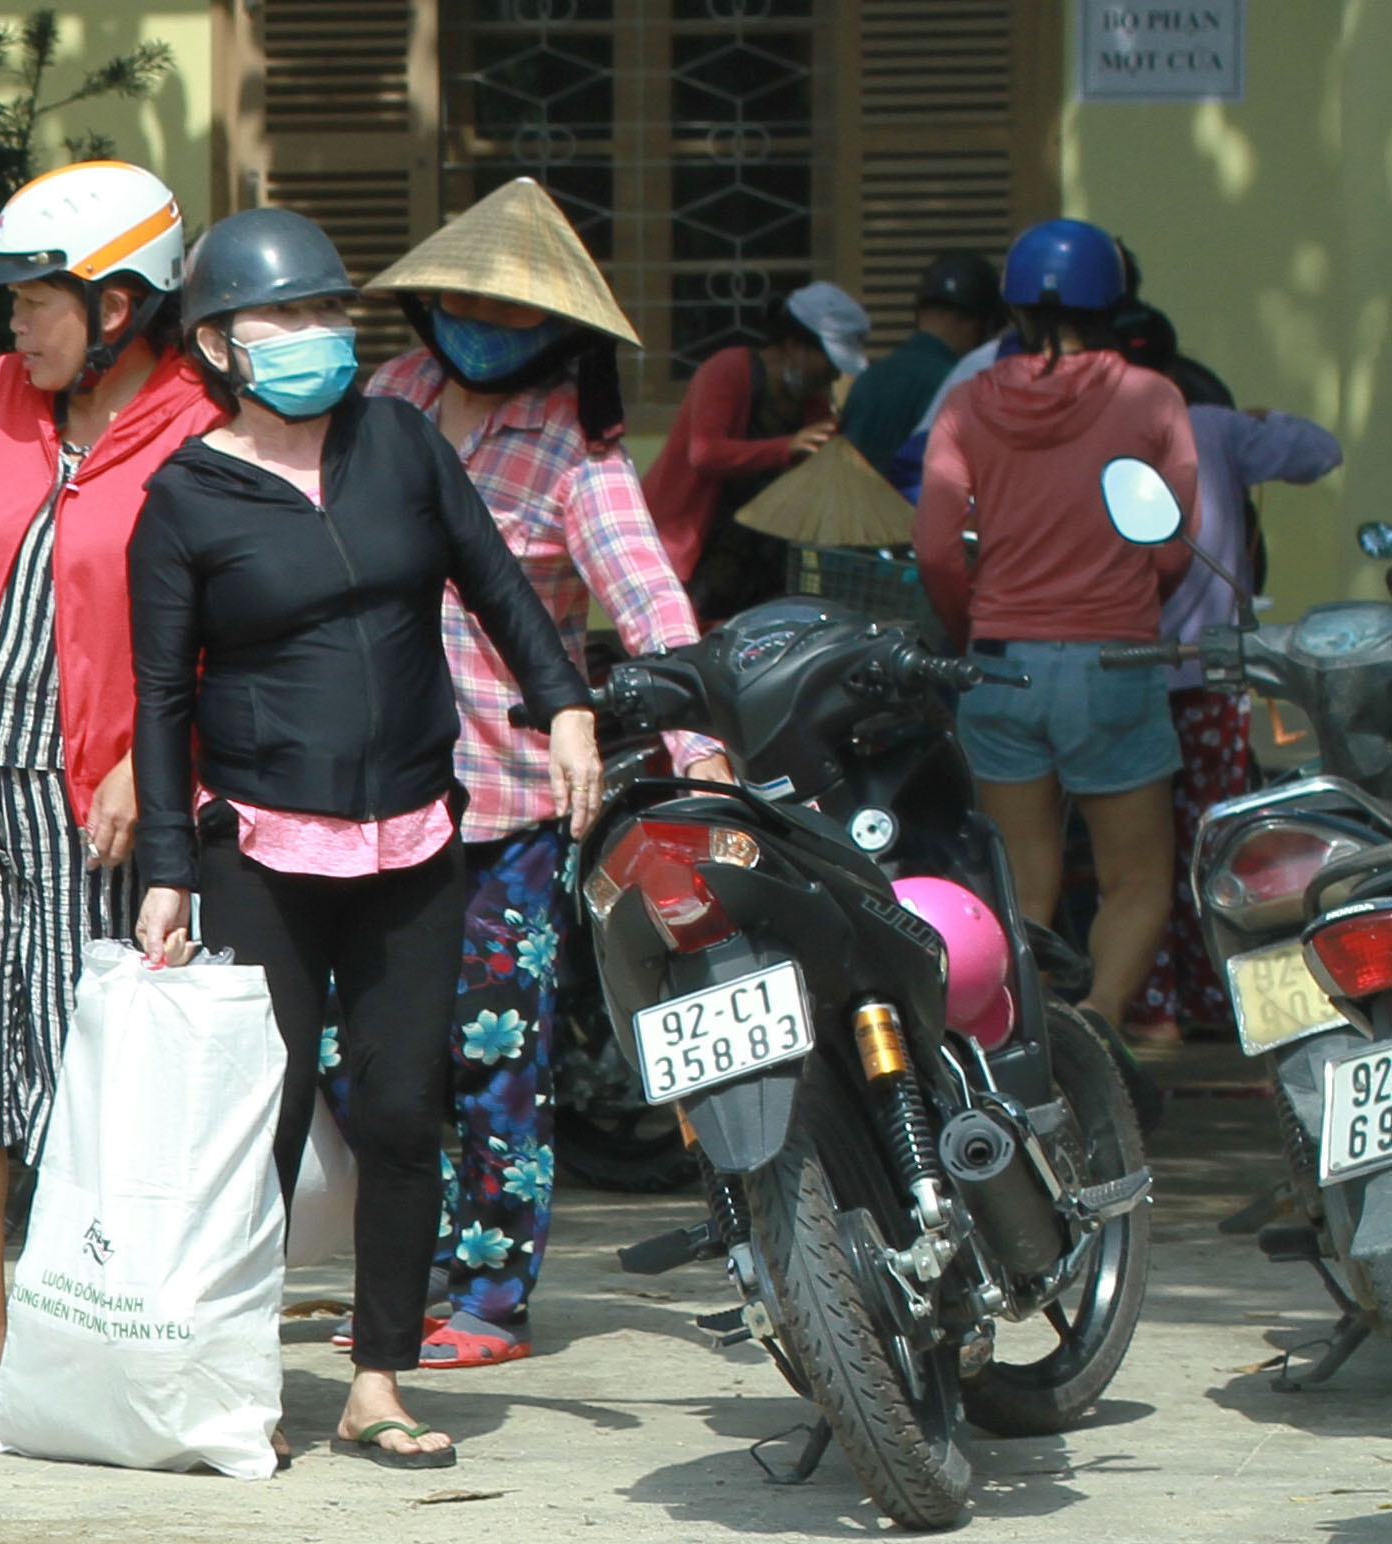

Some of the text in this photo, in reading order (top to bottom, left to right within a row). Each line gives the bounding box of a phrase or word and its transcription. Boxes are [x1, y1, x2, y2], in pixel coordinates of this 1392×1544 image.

[661, 979, 773, 1047] 92-C1
[654, 1014, 801, 1093] 358.83
[1352, 1056, 1392, 1109] 92
[110, 1319, 151, 1340] THÂN
